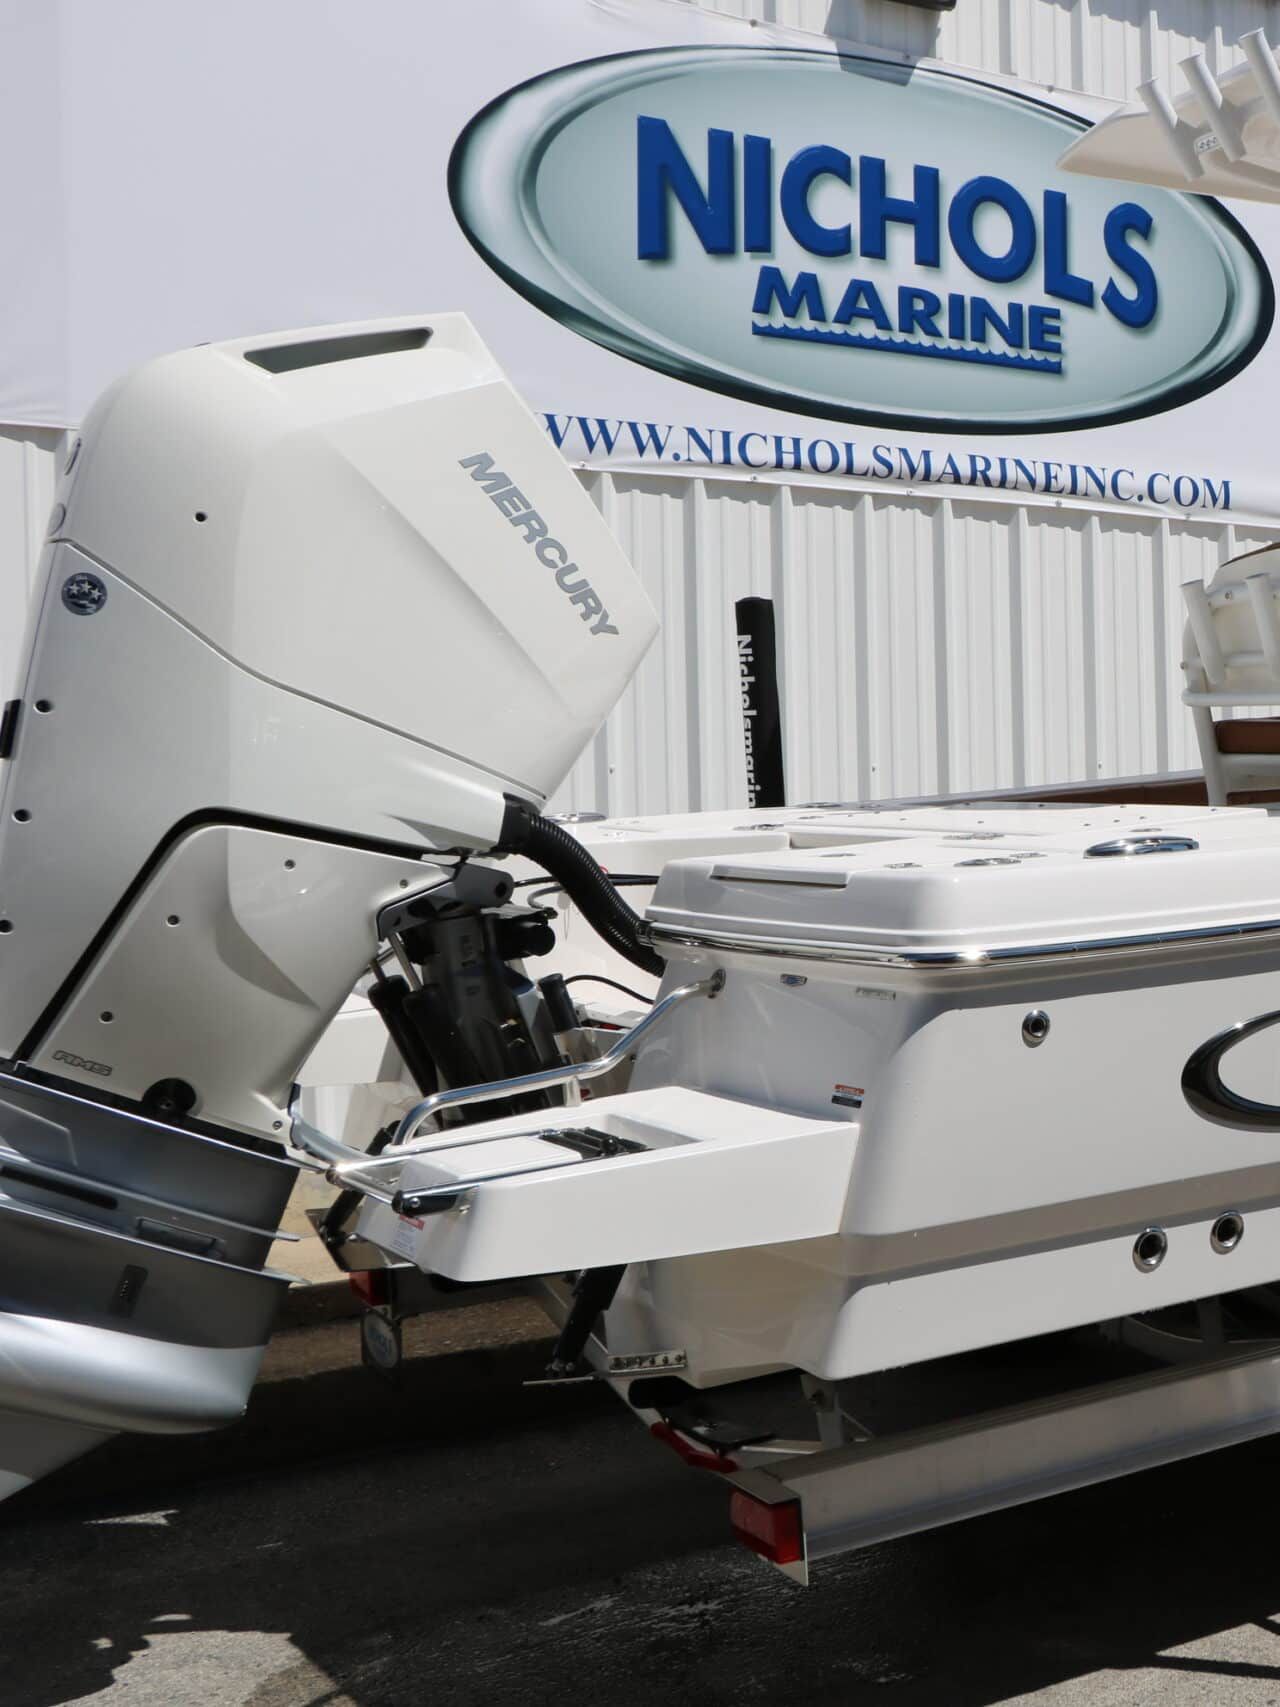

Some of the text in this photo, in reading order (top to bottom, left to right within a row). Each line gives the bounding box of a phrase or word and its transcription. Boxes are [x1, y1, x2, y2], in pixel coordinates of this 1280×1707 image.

[637, 114, 1158, 329] NICHOLS
[752, 265, 1063, 353] MARINE
[457, 452, 620, 636] MERCURY
